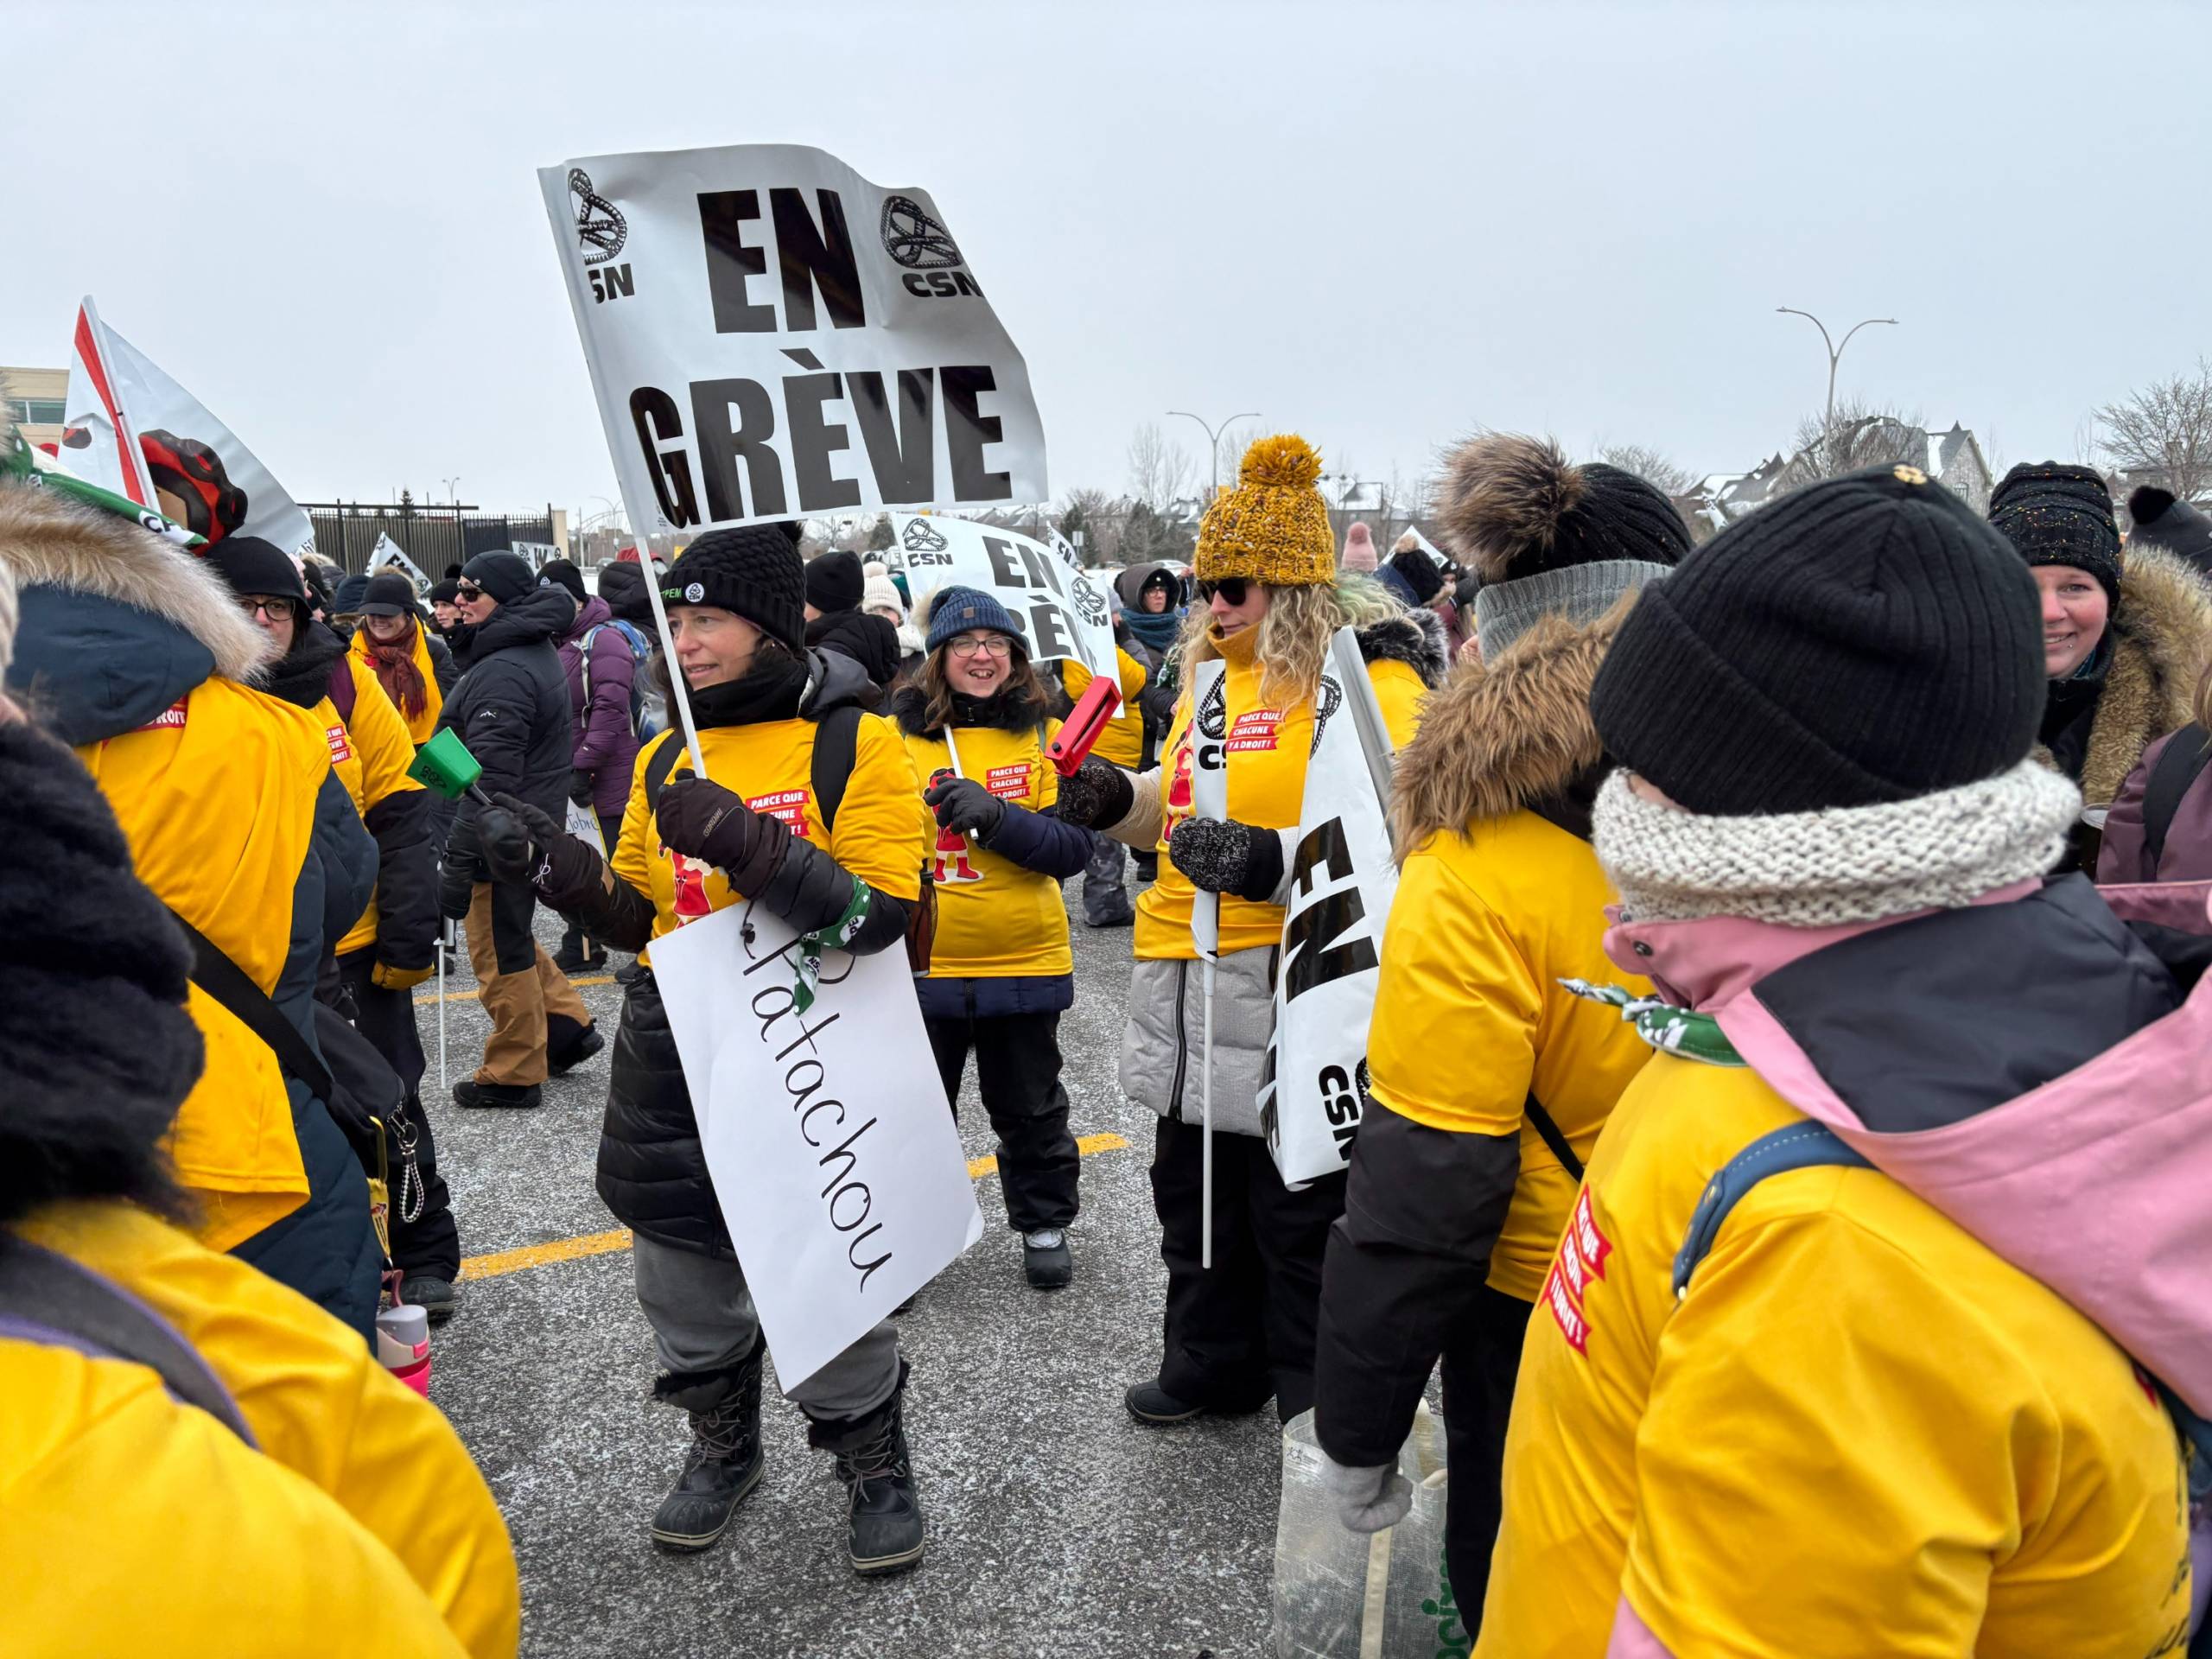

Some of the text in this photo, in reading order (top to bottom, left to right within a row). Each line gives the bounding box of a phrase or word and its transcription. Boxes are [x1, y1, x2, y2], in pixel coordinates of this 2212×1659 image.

[696, 188, 866, 334] EN
[588, 263, 635, 304] SN
[902, 272, 985, 298] CSN
[629, 347, 1013, 530] GRÈVE
[907, 553, 953, 567] CSN
[982, 536, 1064, 598] EN
[1262, 711, 1280, 721] QUE
[1233, 726, 1268, 736] CHACUNE
[991, 768, 1013, 778] PARCE
[991, 778, 1022, 788] CHACUNE
[751, 791, 804, 810] PARCE QUE
